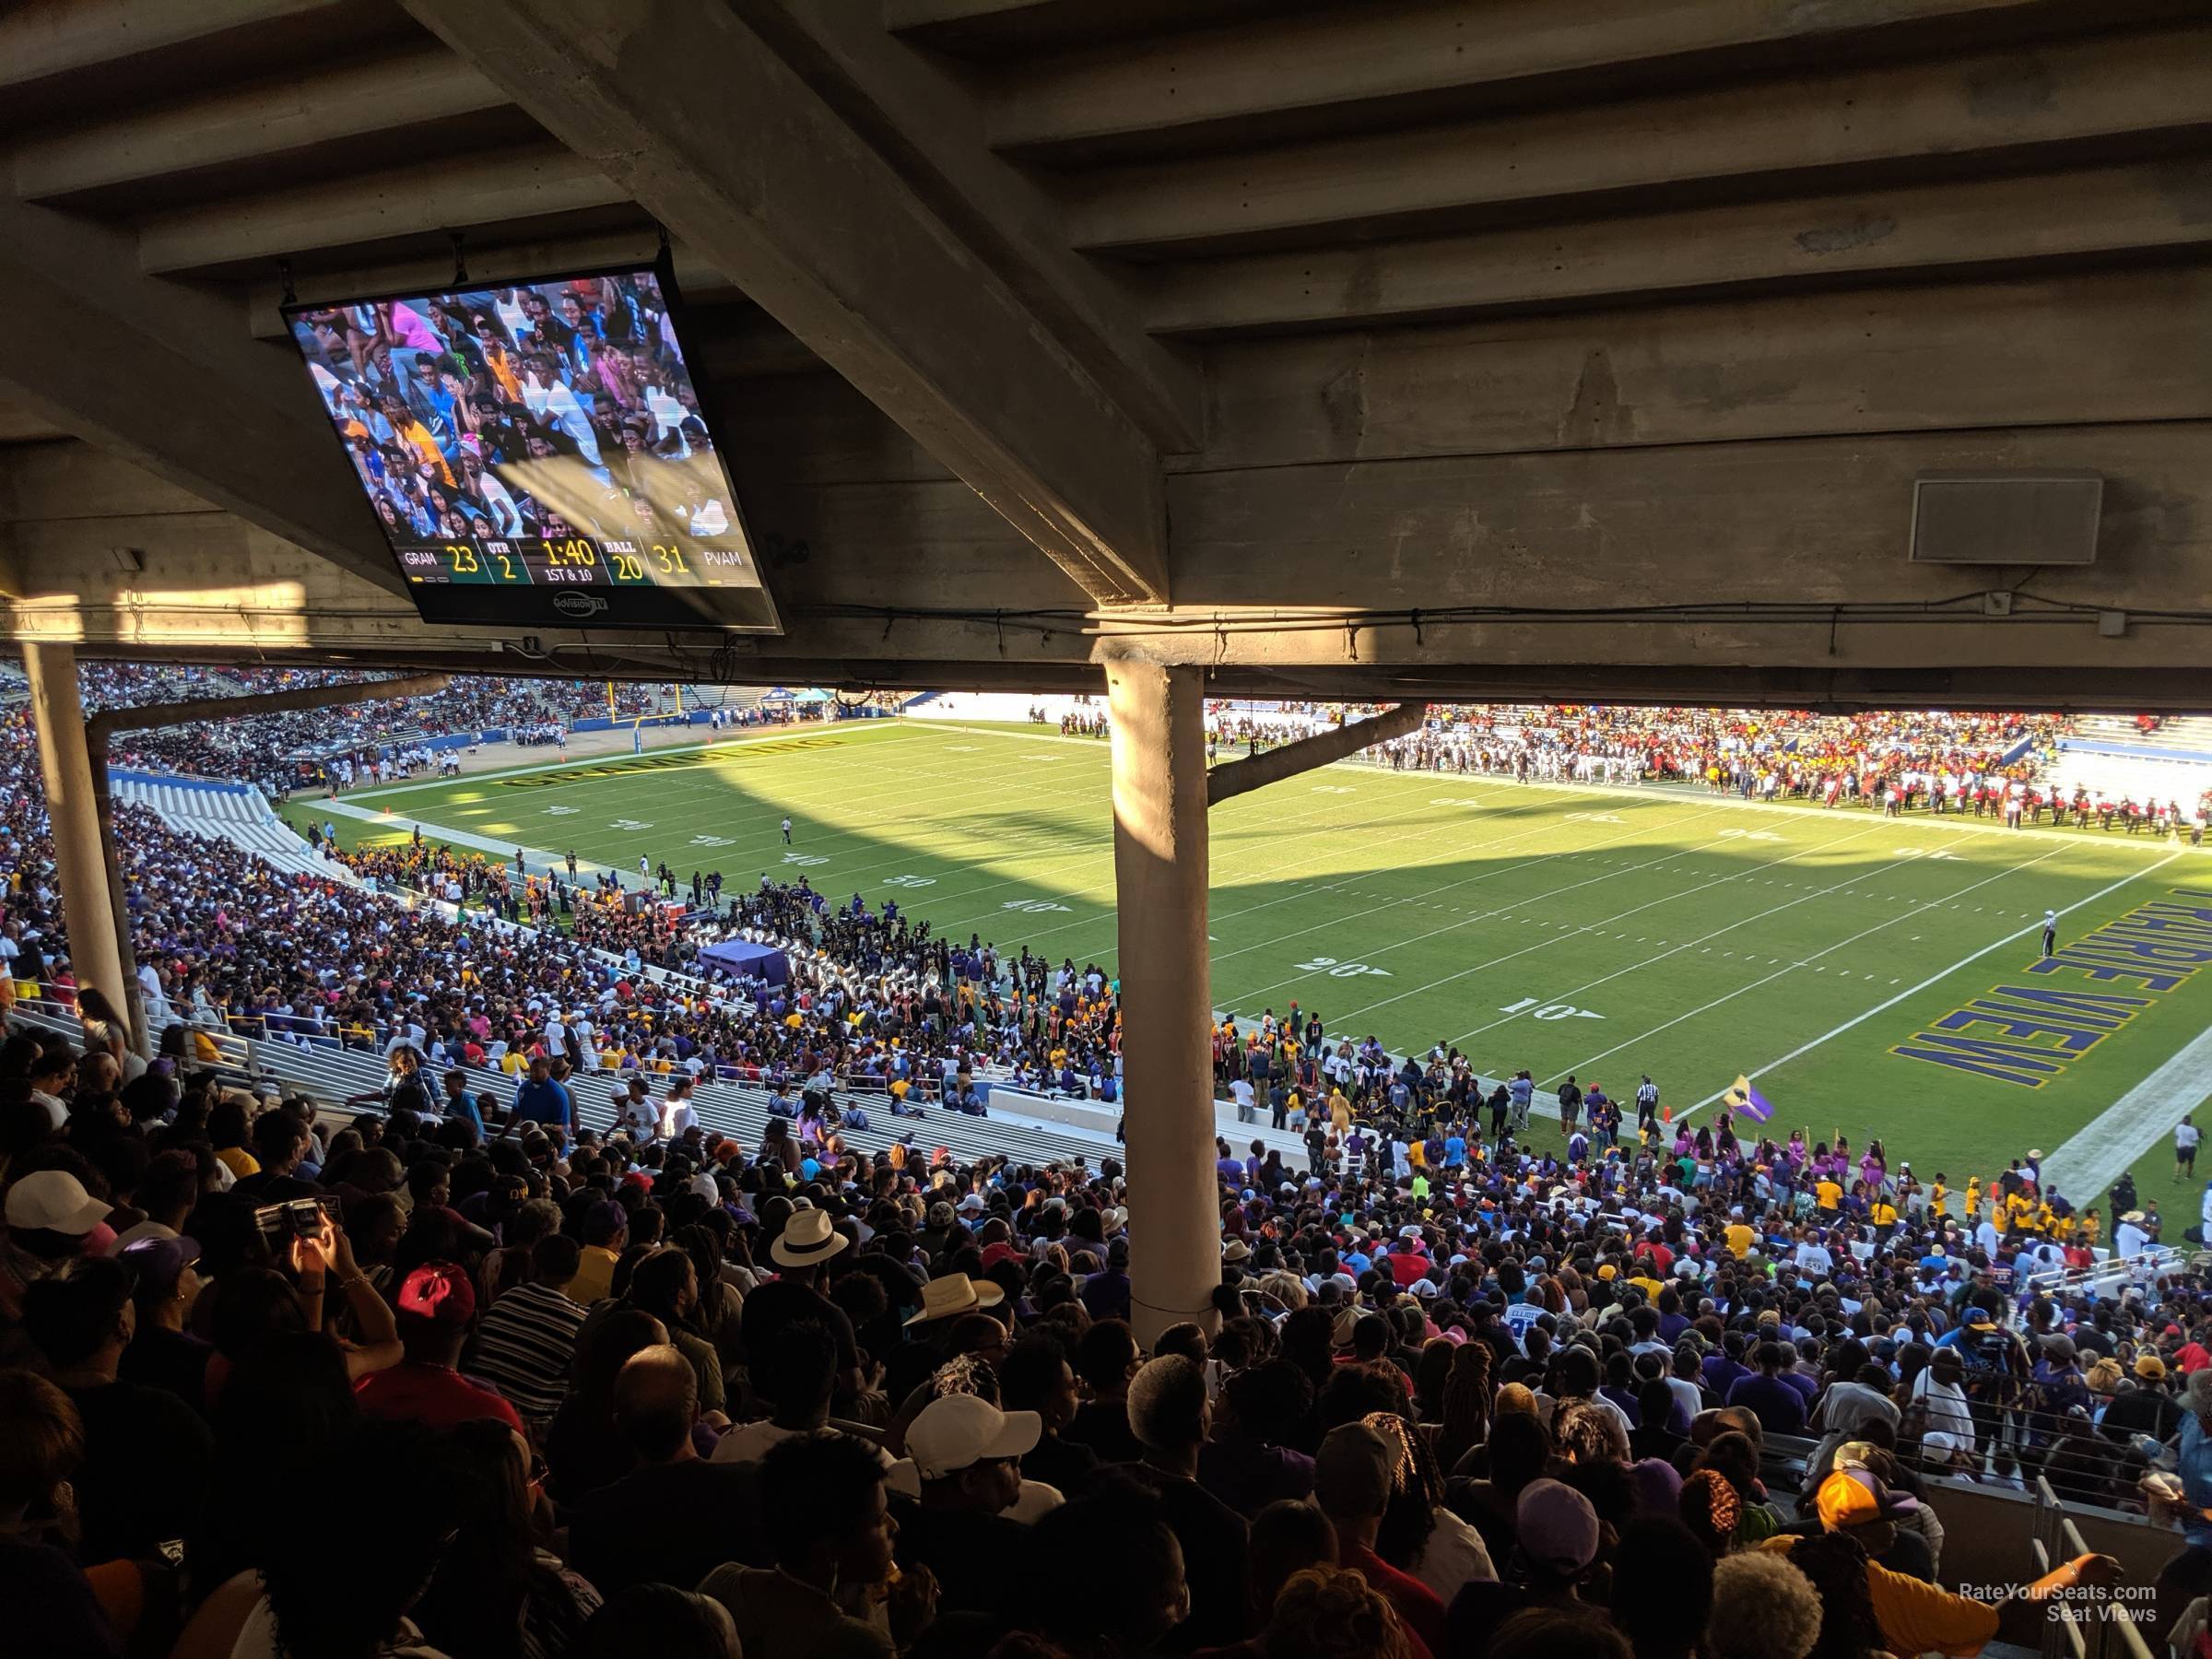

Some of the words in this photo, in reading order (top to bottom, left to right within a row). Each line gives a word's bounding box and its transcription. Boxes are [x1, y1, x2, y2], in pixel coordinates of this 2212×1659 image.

[487, 542, 511, 554] QTR
[543, 539, 594, 566] 1:40
[604, 542, 637, 553] BALL
[405, 553, 437, 565] GRAM
[446, 546, 478, 572] 23
[498, 556, 516, 578] 2
[612, 556, 643, 580] 20
[653, 545, 689, 573] 31
[703, 552, 743, 566] PVAM
[545, 569, 566, 582] 1ST
[568, 571, 578, 582] &
[579, 569, 593, 582] 10
[502, 738, 845, 788] GRAMBLING
[883, 875, 937, 888] 50
[1002, 899, 1058, 912] 40
[1292, 957, 1369, 977] 20
[1498, 997, 1577, 1020] 10
